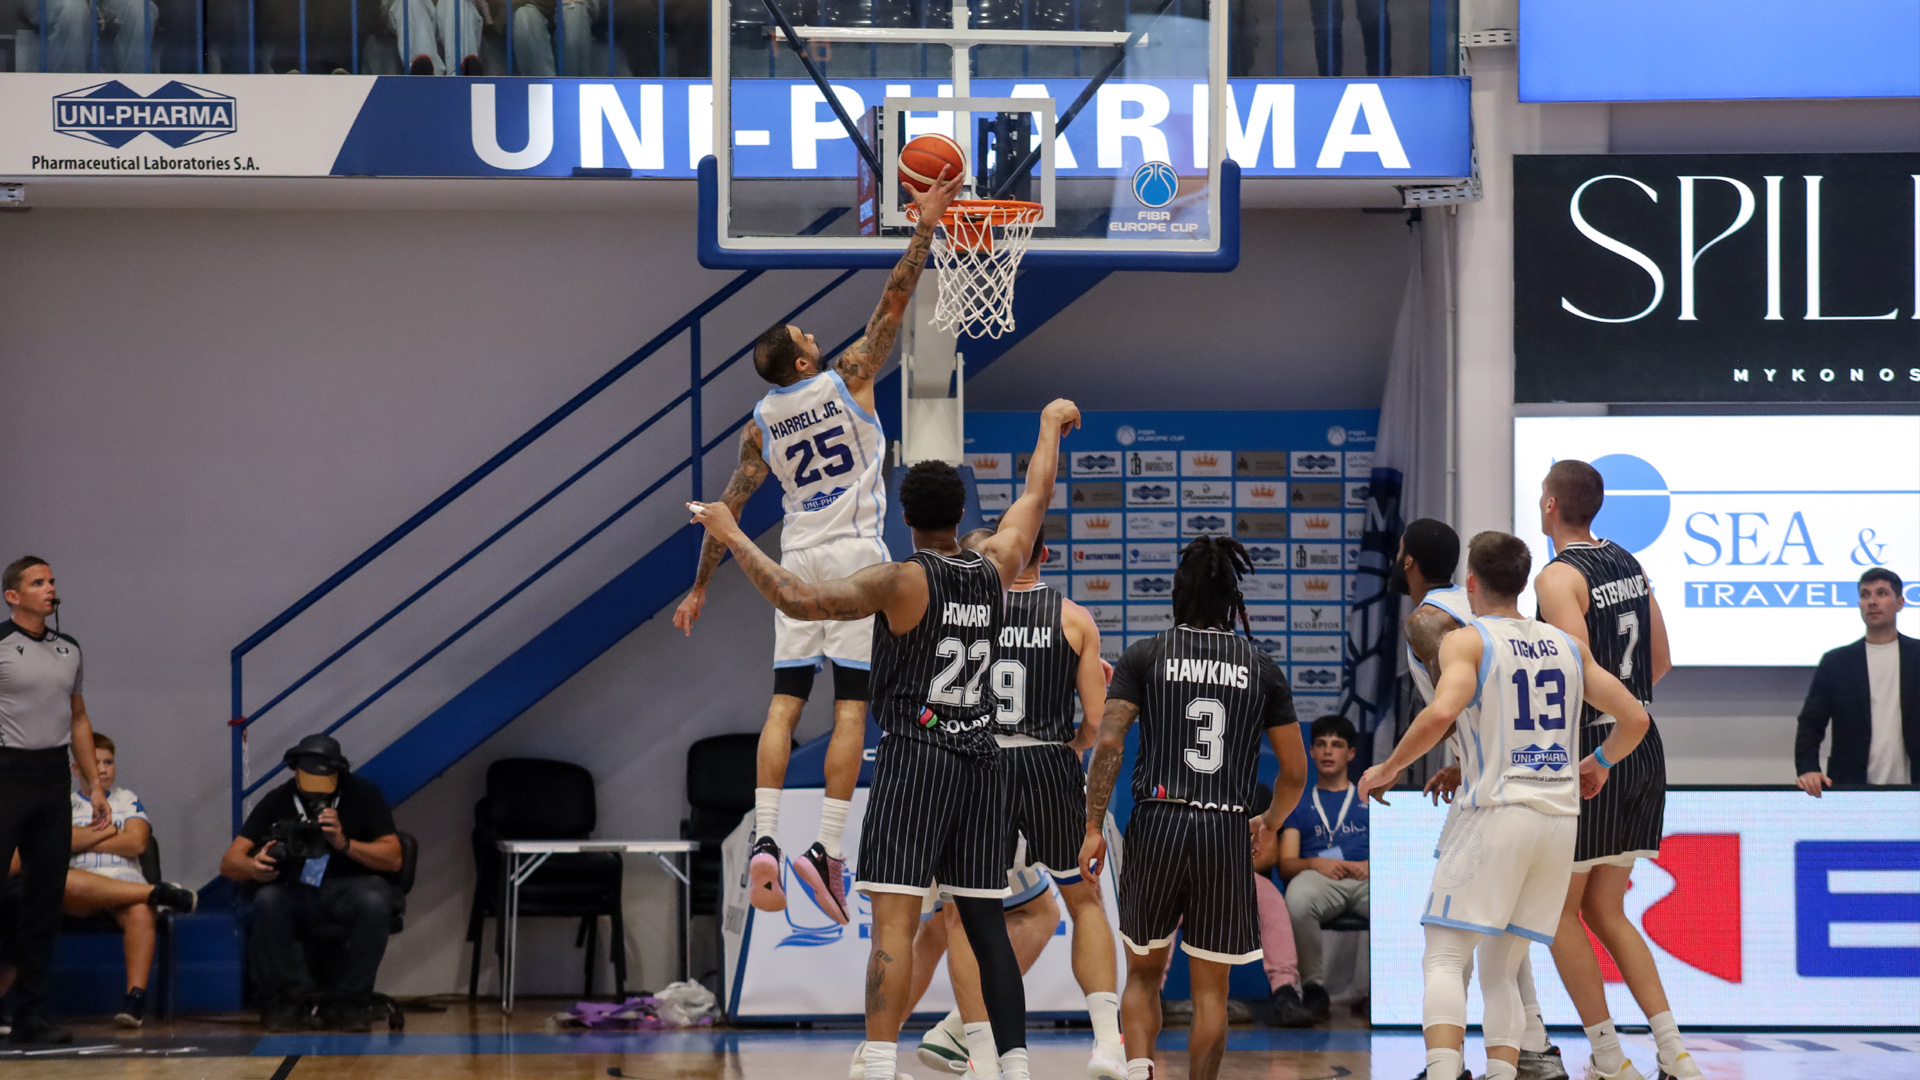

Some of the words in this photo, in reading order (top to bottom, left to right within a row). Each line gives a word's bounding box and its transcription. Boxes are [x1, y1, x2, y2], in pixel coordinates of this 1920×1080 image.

[60, 105, 230, 125] UNI-PHARMA
[32, 155, 140, 171] Pharmaceutical
[144, 155, 230, 171] Laboratories
[234, 156, 260, 171] S.A.
[1109, 222, 1167, 232] EUROPE
[1170, 223, 1199, 232] CUP
[1137, 211, 1171, 221] FIBA
[1733, 367, 1920, 383] MYKONOS
[769, 408, 822, 440] HARRELL
[822, 400, 842, 419] JR.
[785, 425, 855, 488] 25
[803, 494, 841, 510] UNI-PHA
[1683, 510, 1825, 567] SEA
[1850, 528, 1889, 567] &
[1691, 583, 1848, 606] TRAVEL
[1293, 621, 1339, 629] SCORPIOS
[1618, 610, 1640, 680] 7
[926, 636, 991, 708] 22
[1166, 658, 1249, 690] HAWKINS
[1512, 668, 1566, 731] 13
[1183, 696, 1226, 774] 3
